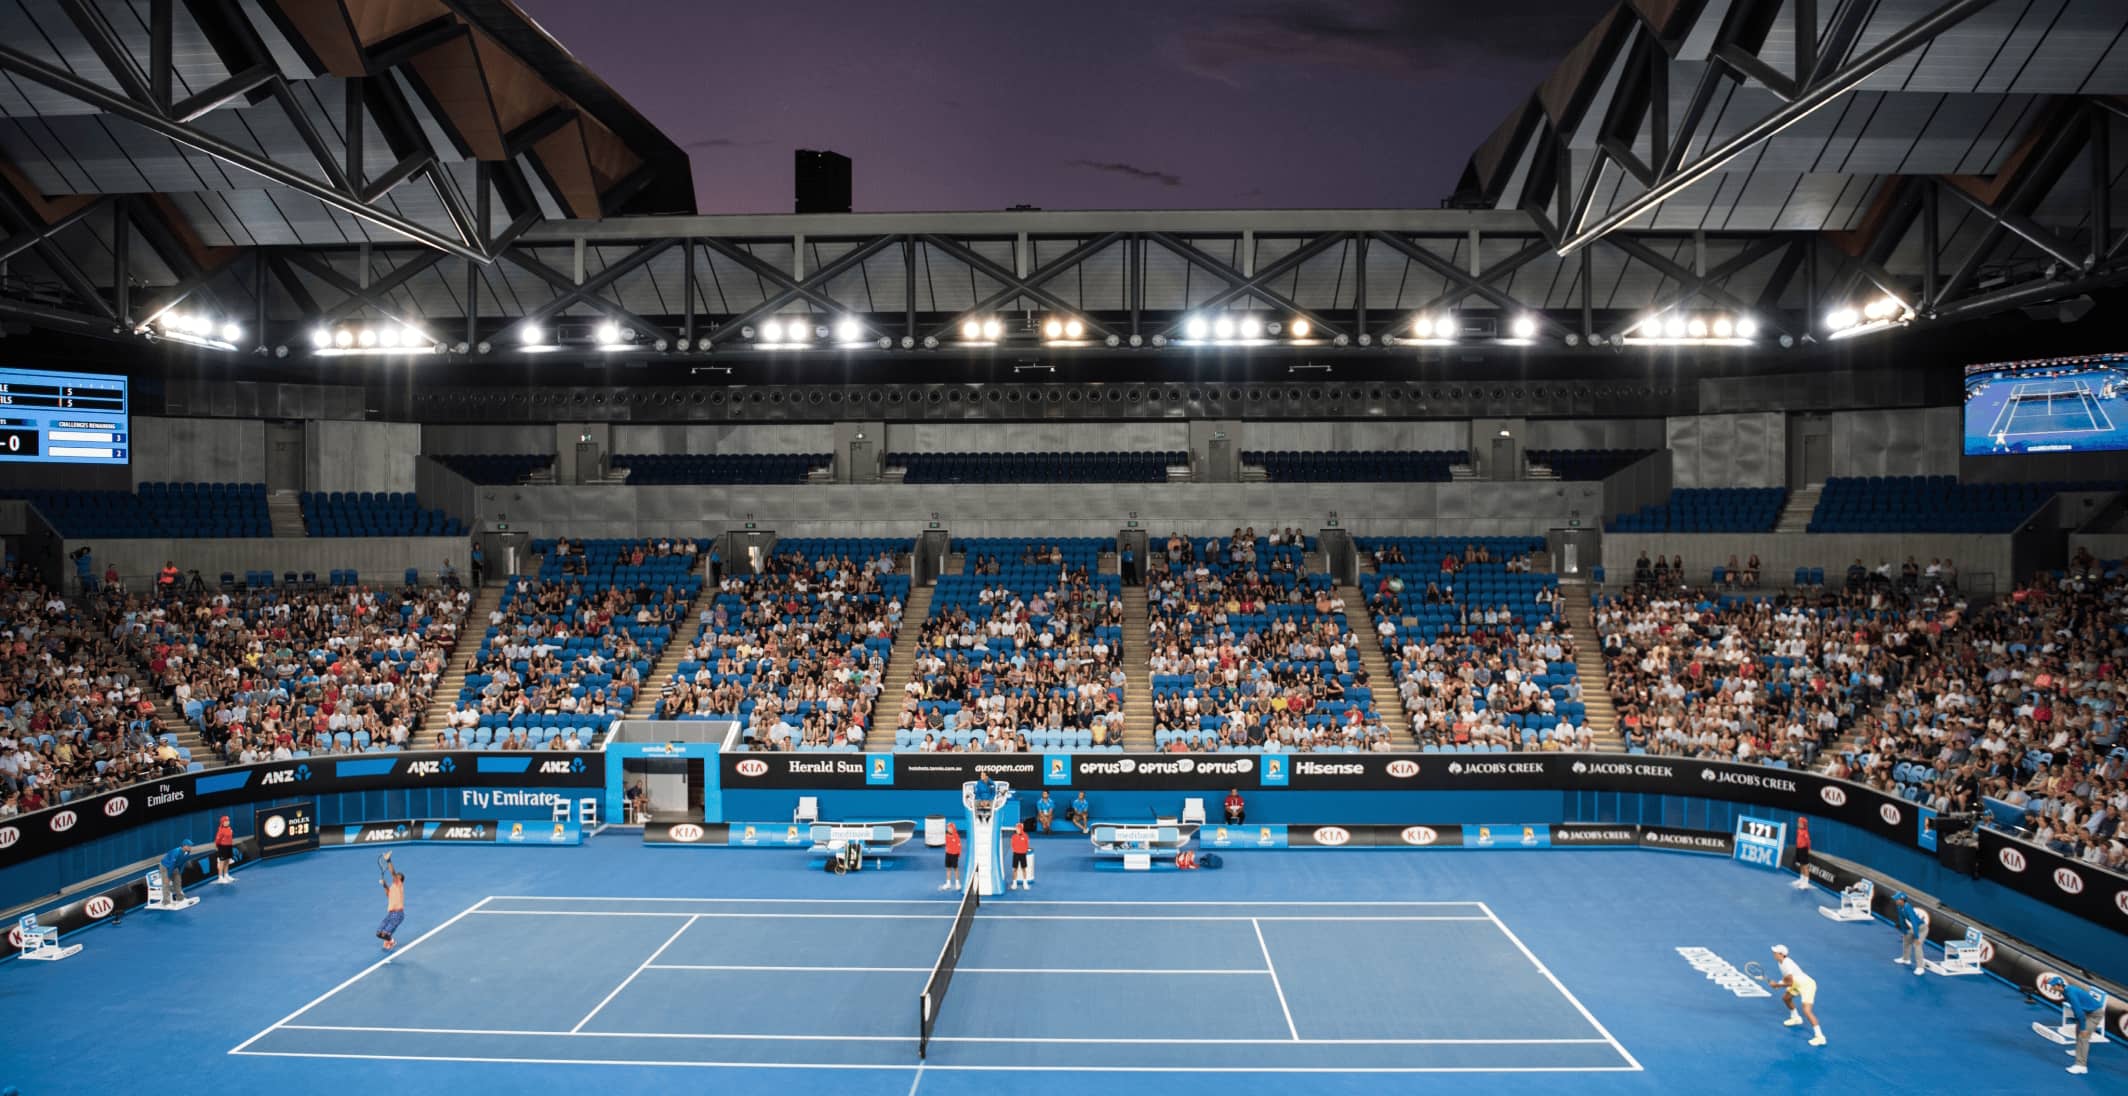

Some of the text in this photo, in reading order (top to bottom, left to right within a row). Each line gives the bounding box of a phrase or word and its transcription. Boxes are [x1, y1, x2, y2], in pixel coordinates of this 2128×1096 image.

[67, 388, 73, 396] 5
[407, 761, 440, 774] ANZ
[539, 761, 570, 773] ANZ
[741, 763, 764, 773] KIA
[789, 760, 864, 773] Herald Sun
[975, 764, 1034, 774] ausopen.com
[1079, 762, 1120, 774] OPTUS
[1138, 762, 1179, 774] OPTUS
[1197, 762, 1238, 774] OPTUS
[1295, 761, 1365, 774] Hisense
[1391, 763, 1414, 774] KIA
[1463, 763, 1544, 774] JACOB'S CREEK
[1588, 763, 1673, 777] JACOB'S CREEK
[261, 770, 294, 785] ANZ
[1717, 771, 1796, 792] JACOB'S CREEK
[159, 784, 171, 793] Fly
[147, 790, 185, 807] Emirates
[462, 790, 561, 809] Fly Emirates
[1824, 788, 1843, 803] KIA
[108, 801, 126, 814] KIA
[1883, 806, 1898, 822] KIA
[54, 813, 74, 829] KIA
[365, 829, 394, 841] ANZ
[445, 827, 473, 838] ANZ
[674, 827, 699, 838] KIA
[1320, 830, 1344, 841] KIA
[1407, 830, 1432, 841] KIA
[1603, 831, 1631, 840] CREEK
[1749, 821, 1772, 838] 171
[1658, 834, 1725, 848] JACOB'S CREEK
[1740, 843, 1774, 866] IBM
[2003, 850, 2022, 869] KIA
[2057, 871, 2079, 891] KIA
[88, 901, 112, 916] KIA
